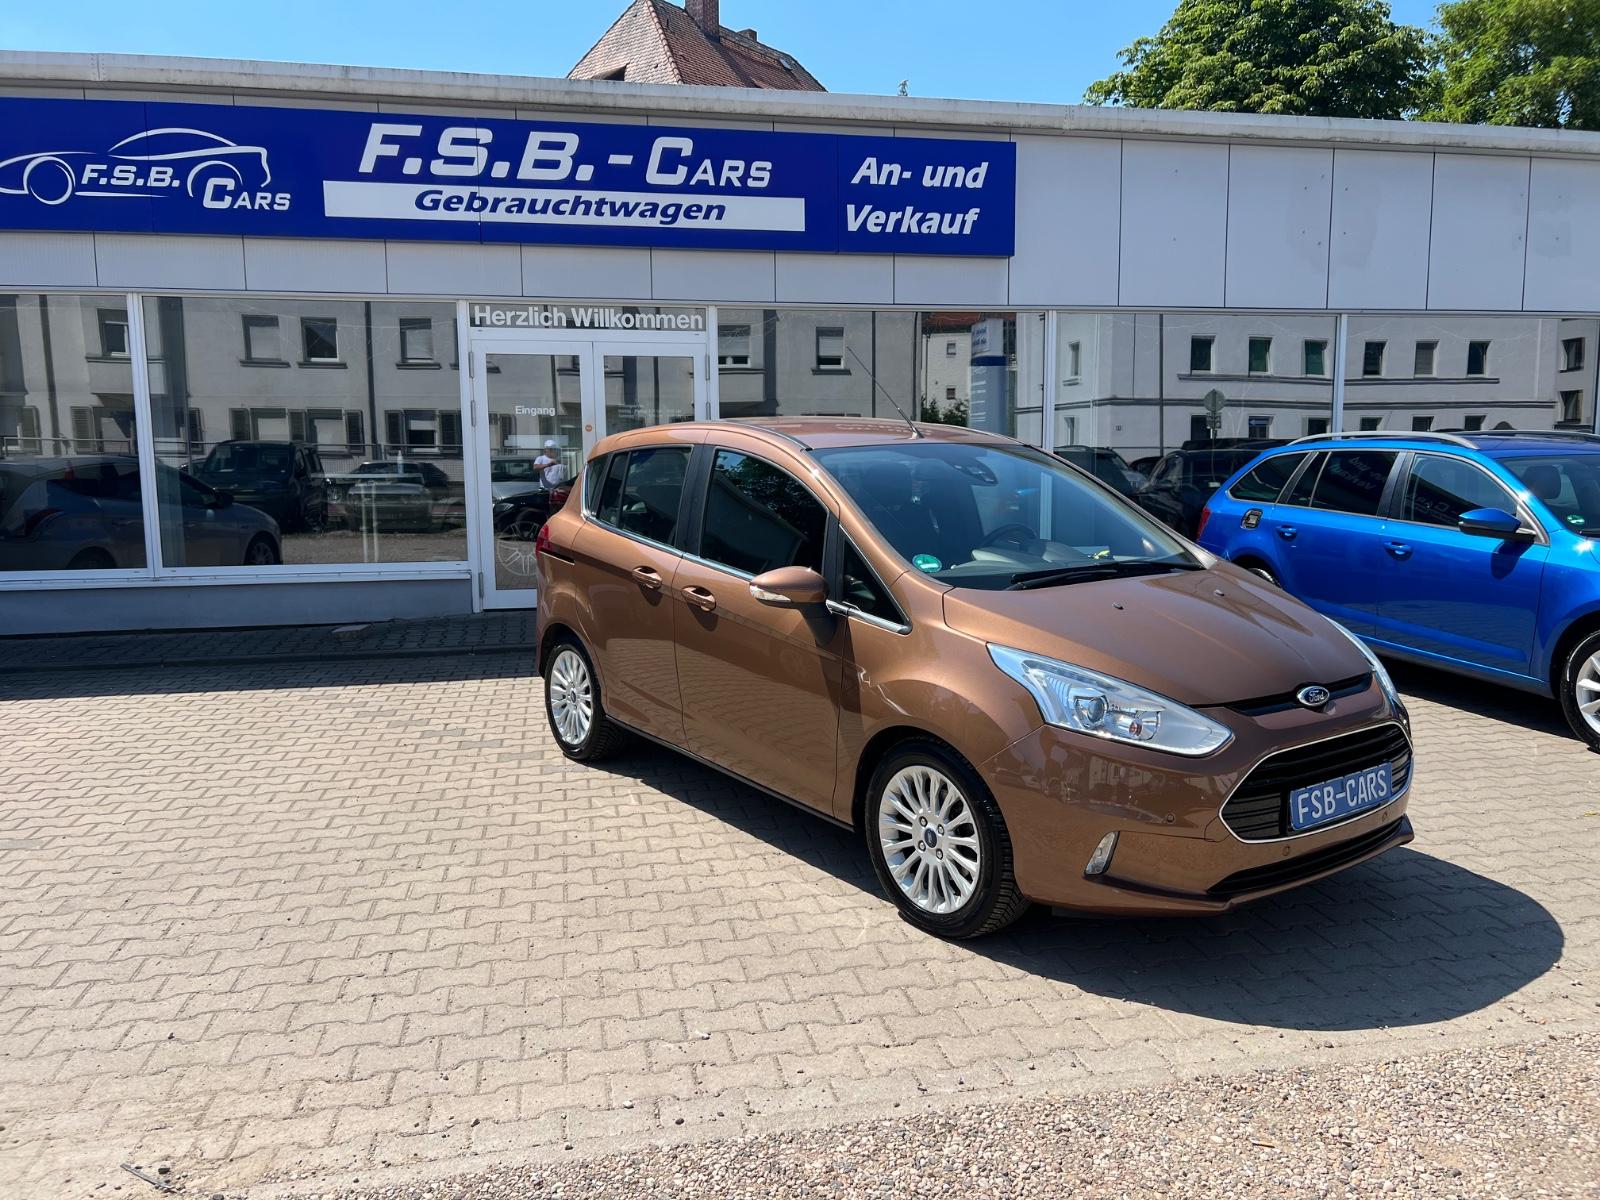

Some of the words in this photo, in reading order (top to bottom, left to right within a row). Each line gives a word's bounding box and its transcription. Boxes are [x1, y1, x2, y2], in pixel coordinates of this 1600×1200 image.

[82, 164, 180, 189] F.S.B.
[851, 157, 912, 186] An-
[922, 161, 989, 189] und
[414, 189, 727, 227] Gebrauchtwagen
[847, 203, 981, 236] Verkauf
[474, 305, 566, 327] Herzlich
[571, 307, 704, 329] Willkommen
[515, 405, 556, 417] Eingang
[1297, 769, 1387, 824] FSB-CARS
